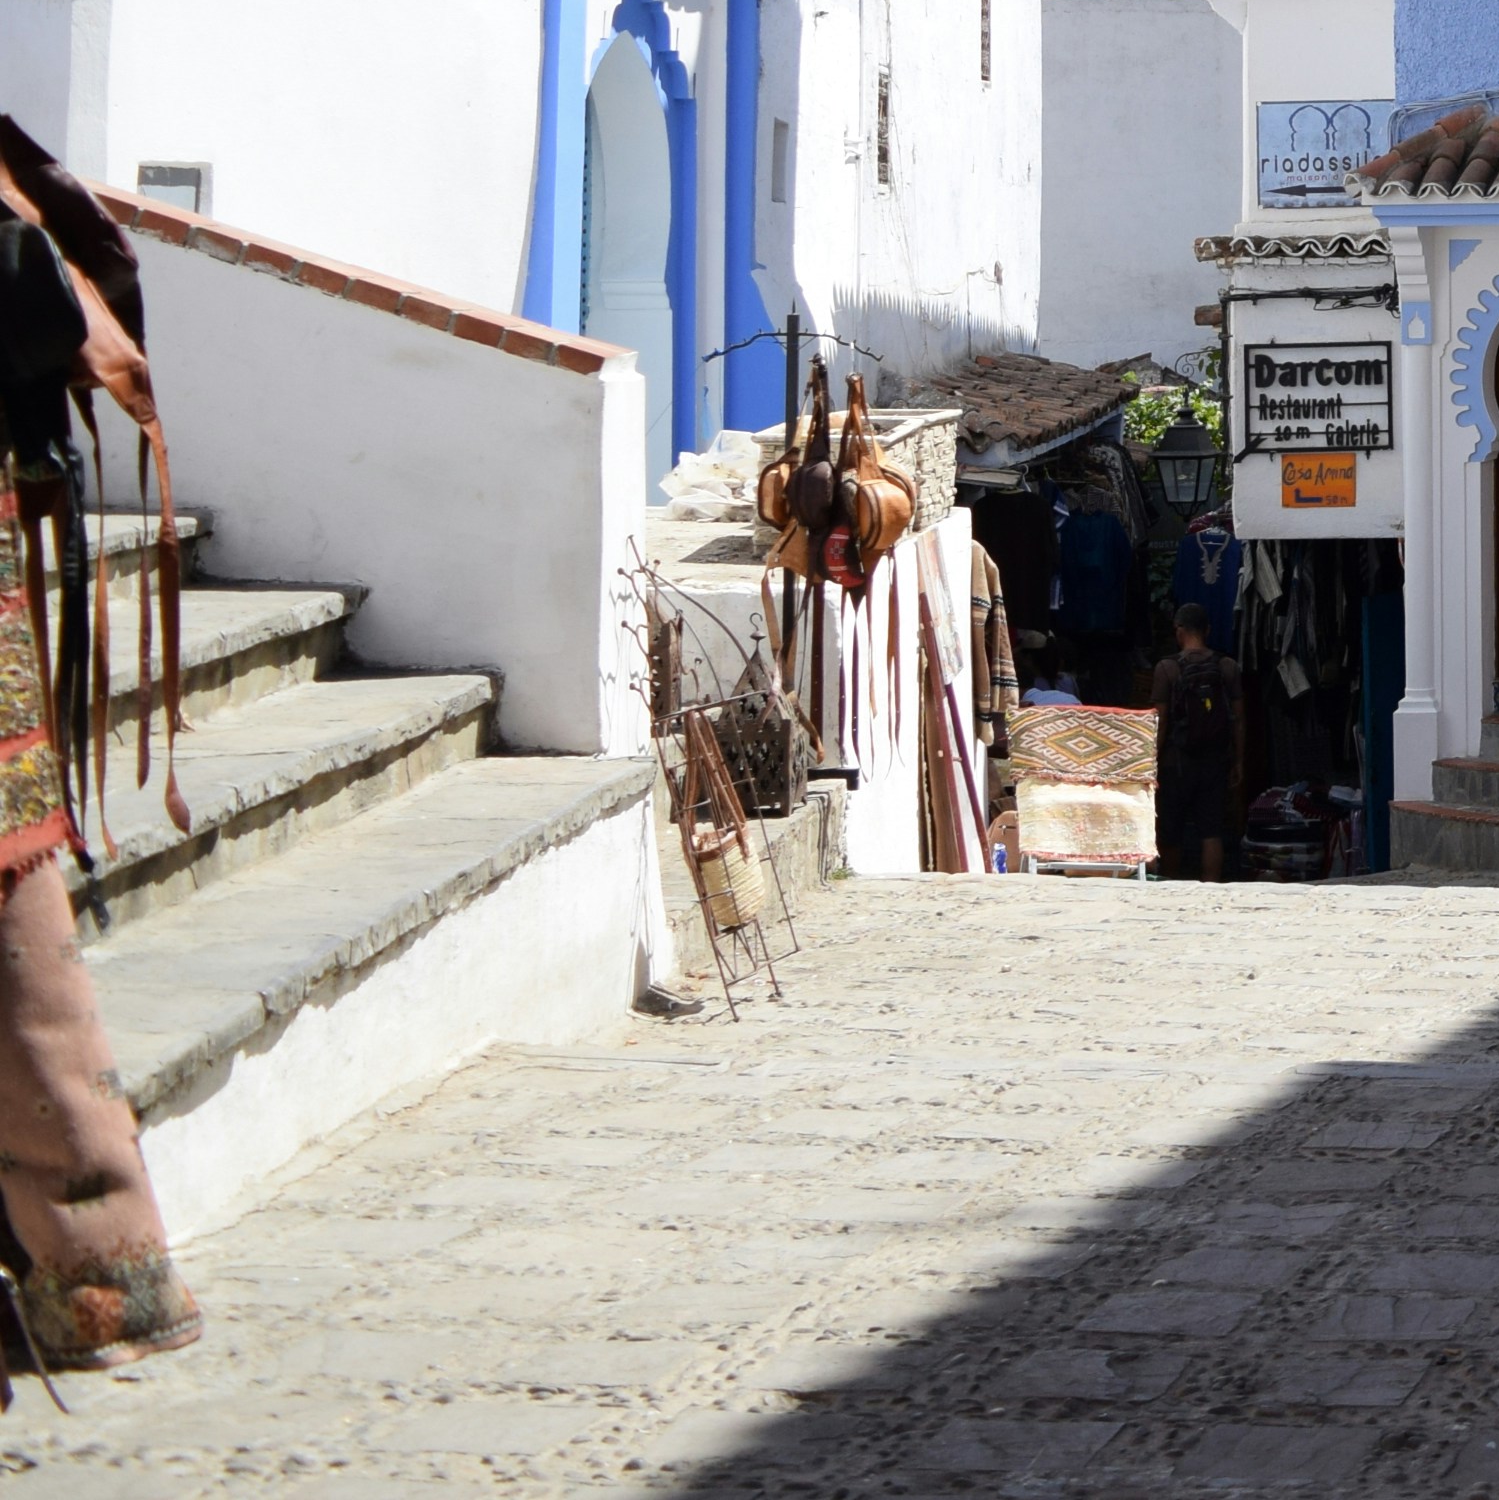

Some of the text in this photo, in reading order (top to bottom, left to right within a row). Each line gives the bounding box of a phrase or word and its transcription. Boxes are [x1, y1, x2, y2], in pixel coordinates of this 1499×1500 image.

[1261, 150, 1382, 173] riadassil
[1286, 173, 1328, 181] maison
[1254, 354, 1384, 388] Darcom
[1258, 393, 1342, 421] Restaurant
[1274, 424, 1292, 442] 10
[1325, 418, 1380, 447] Galerie
[1282, 461, 1313, 485] Casa
